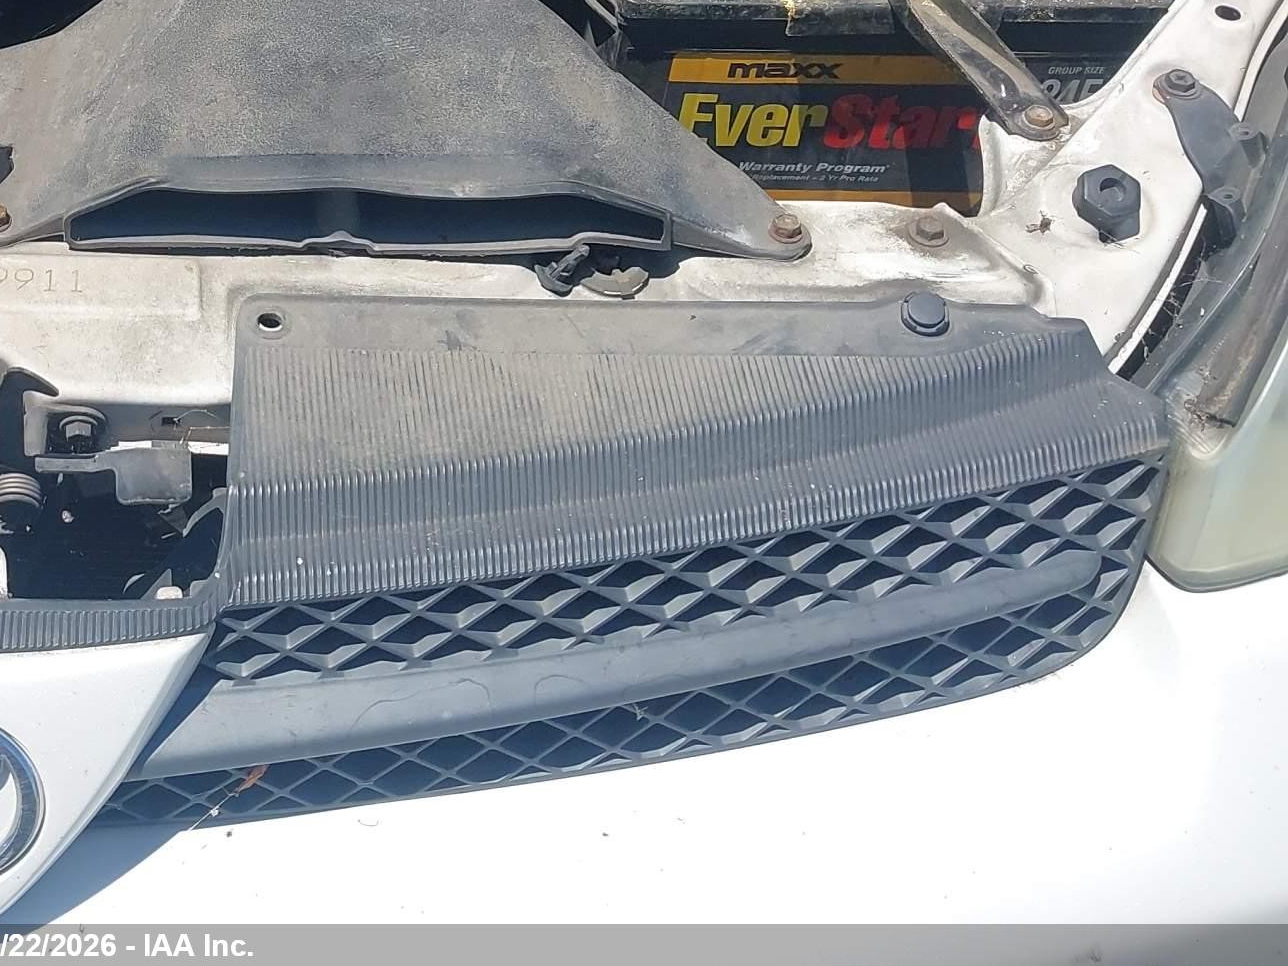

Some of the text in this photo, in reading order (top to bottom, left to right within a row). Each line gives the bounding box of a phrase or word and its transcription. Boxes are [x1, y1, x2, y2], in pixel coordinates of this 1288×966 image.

[728, 62, 843, 79] maxx
[1048, 66, 1105, 75] GROUP SIZE
[739, 161, 812, 174] Warranty
